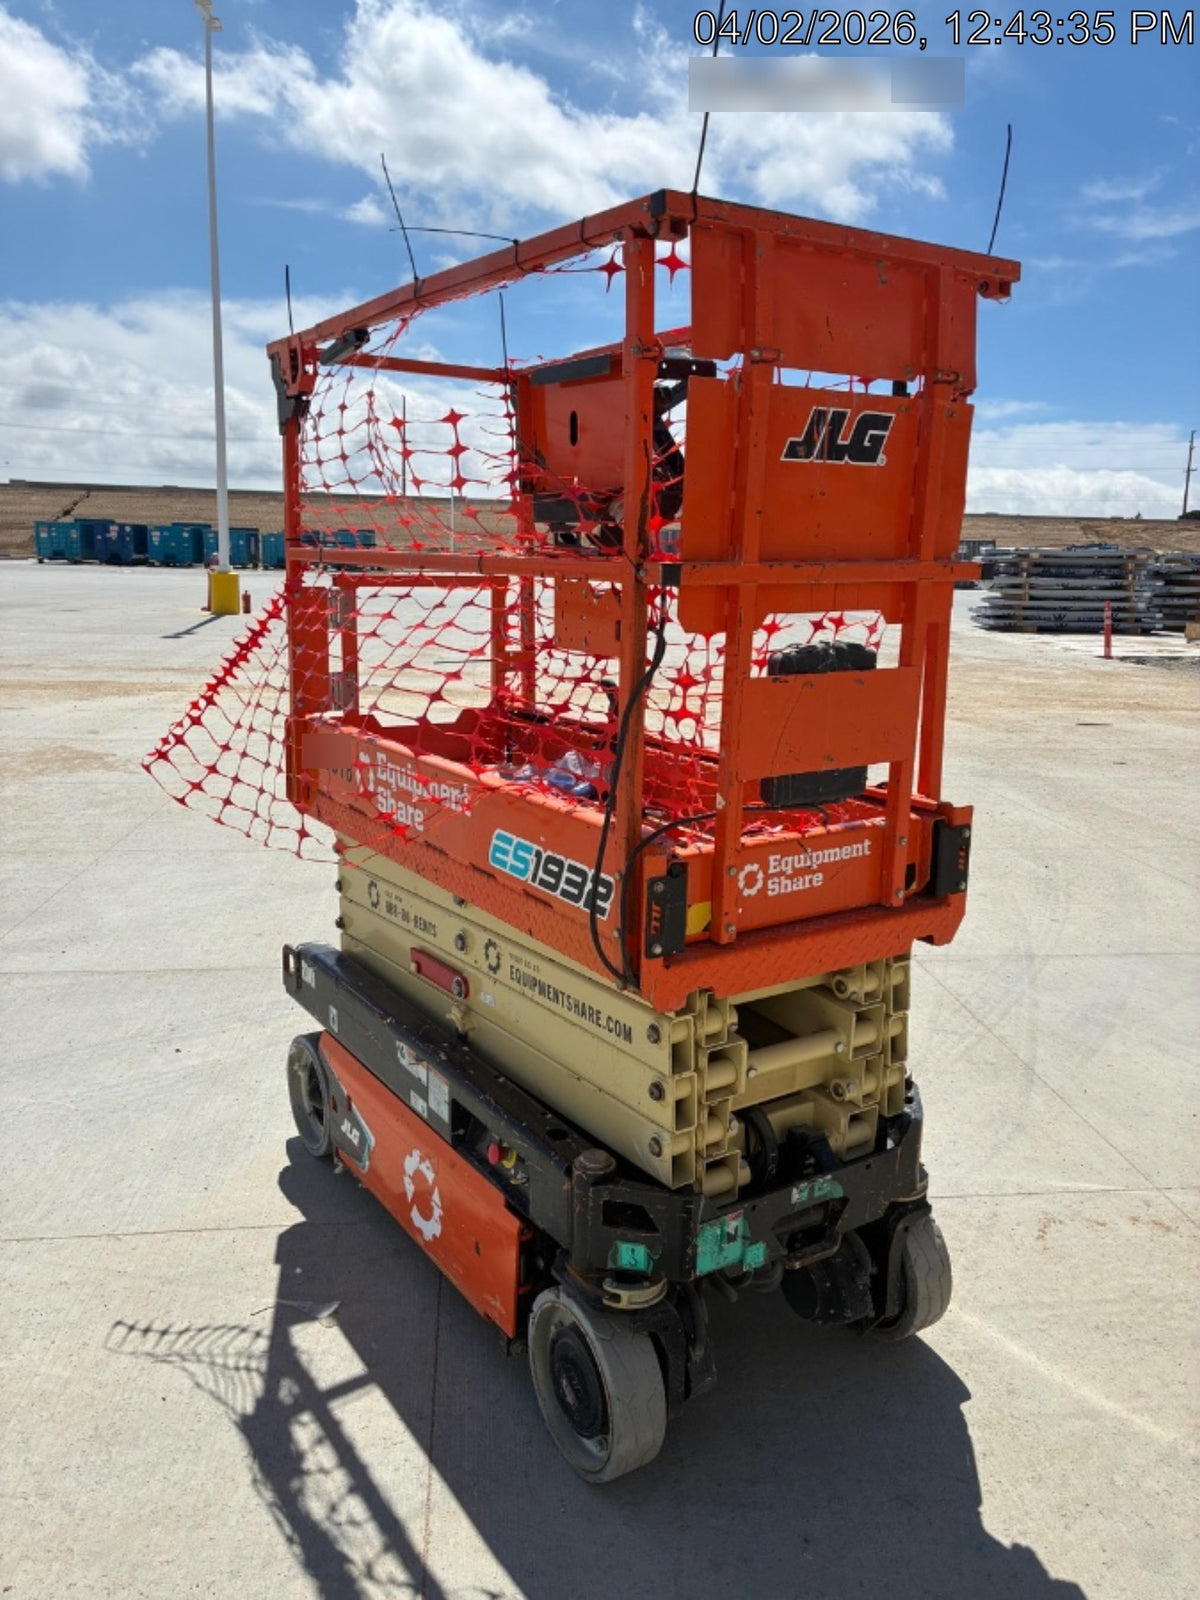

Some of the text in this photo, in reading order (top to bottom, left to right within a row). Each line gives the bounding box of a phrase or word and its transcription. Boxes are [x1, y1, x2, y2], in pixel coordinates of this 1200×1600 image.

[780, 406, 896, 466] JLG
[376, 786, 425, 832] Share
[489, 828, 616, 921] ES1932
[767, 870, 824, 897] Share
[768, 839, 871, 876] Equipment
[509, 964, 633, 1044] EQUIPMENTSHARE.COM
